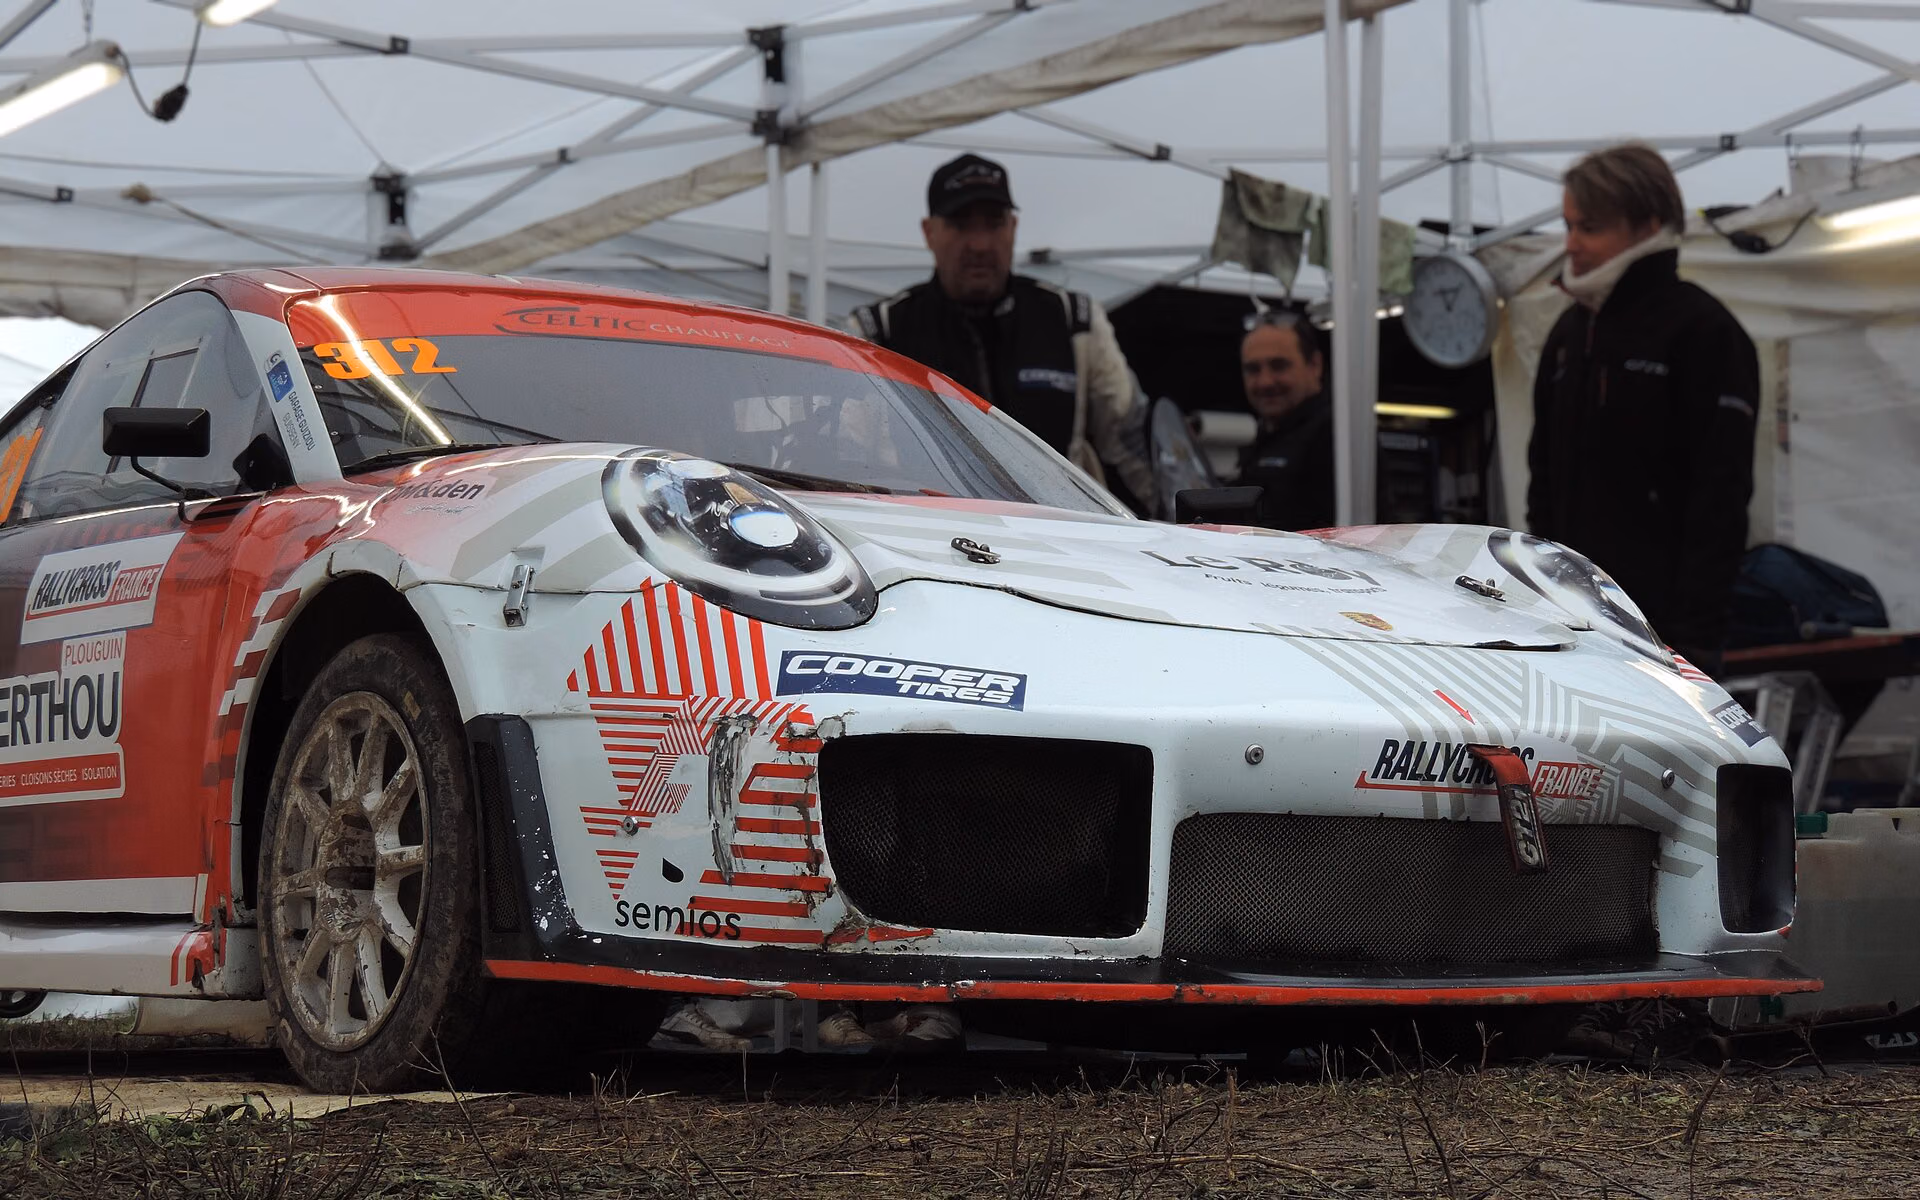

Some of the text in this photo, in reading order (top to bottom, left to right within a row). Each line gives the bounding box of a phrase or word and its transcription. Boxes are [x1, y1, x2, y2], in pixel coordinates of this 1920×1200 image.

[518, 312, 790, 349] CELTIC CHAUFFAGE
[313, 338, 458, 380] 312
[288, 391, 304, 421] GARAGE
[32, 560, 160, 610] RALLYCROSS FRANCE
[65, 636, 122, 666] PLOUGUIN
[785, 654, 1021, 693] COOPER
[896, 679, 1014, 704] TIRES
[0, 671, 120, 747] ERTHOU
[21, 771, 53, 786] CLOISONS
[81, 765, 117, 781] ISOLATION
[1533, 765, 1602, 799] FRANCE
[615, 896, 741, 941] semios
